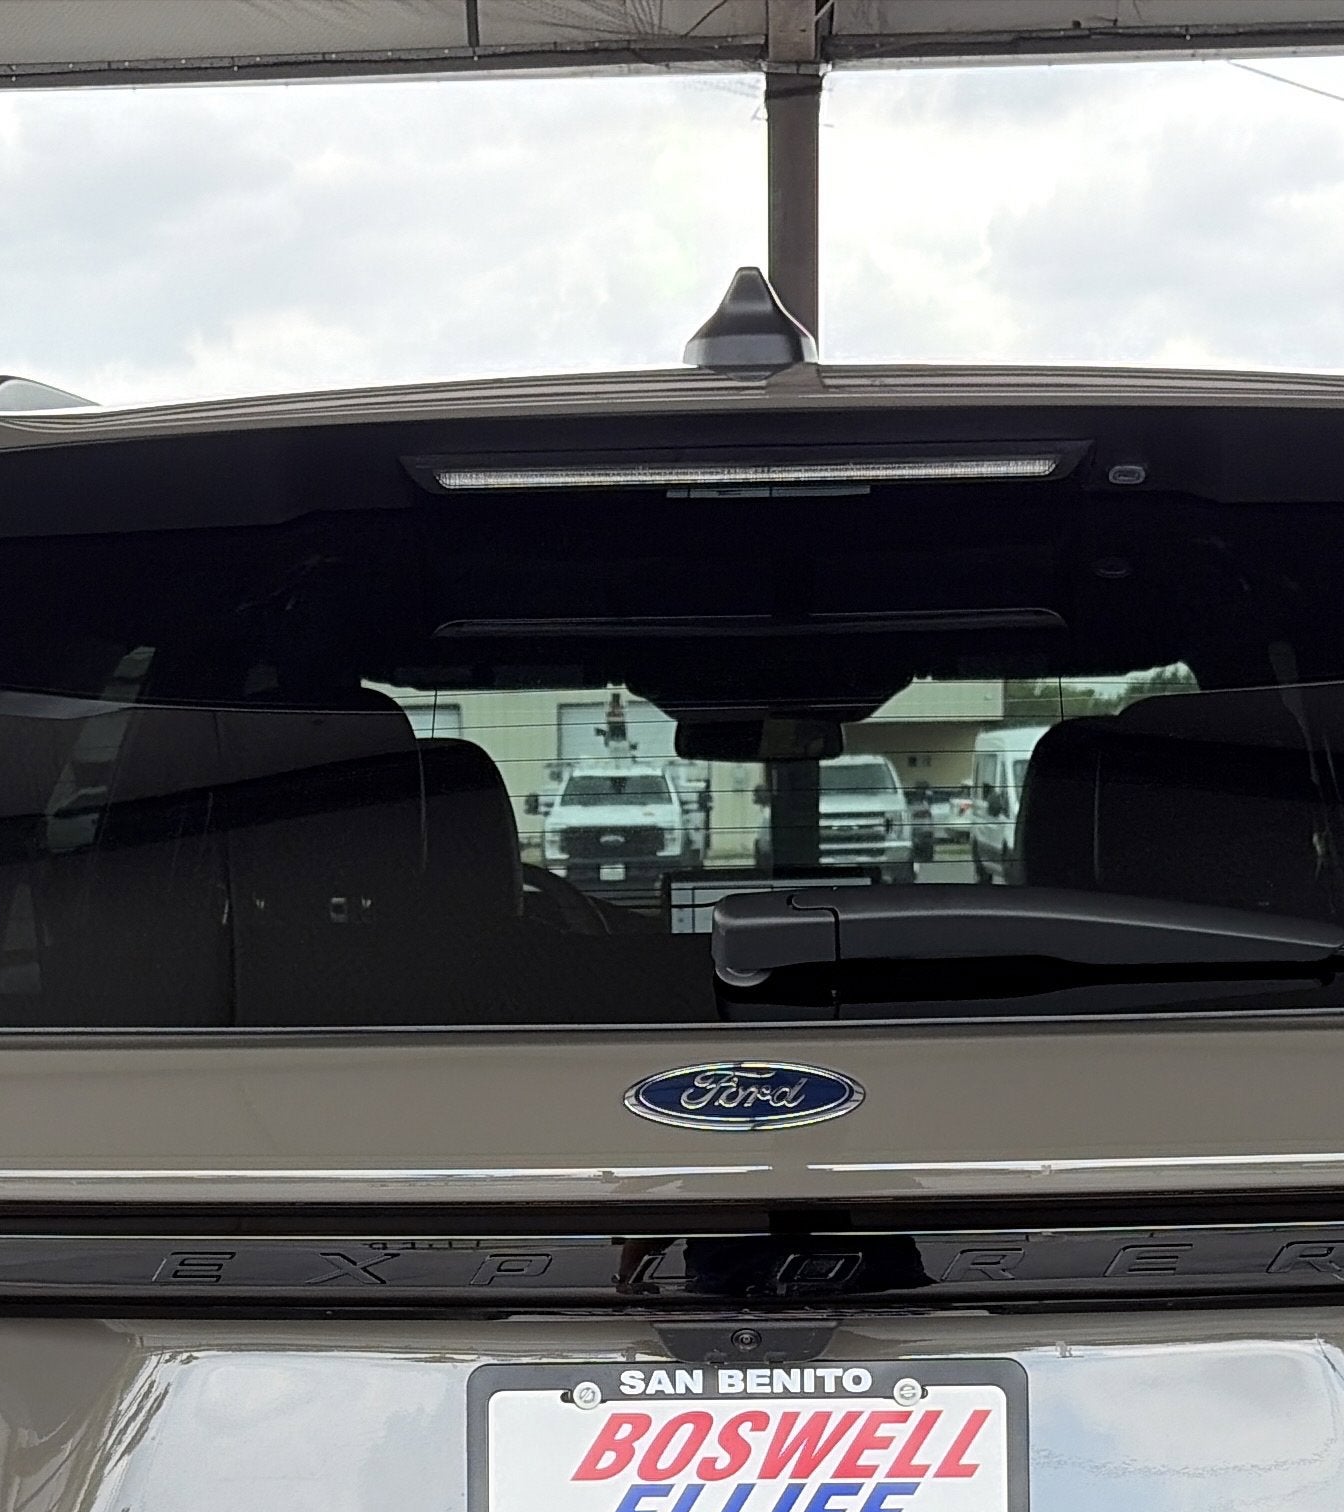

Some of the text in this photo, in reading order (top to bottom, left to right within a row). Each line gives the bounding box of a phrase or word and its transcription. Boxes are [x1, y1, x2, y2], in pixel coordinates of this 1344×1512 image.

[680, 1069, 806, 1110] Ford
[620, 1367, 873, 1395] SAN BENITO
[571, 1409, 993, 1481] BOSWELL
